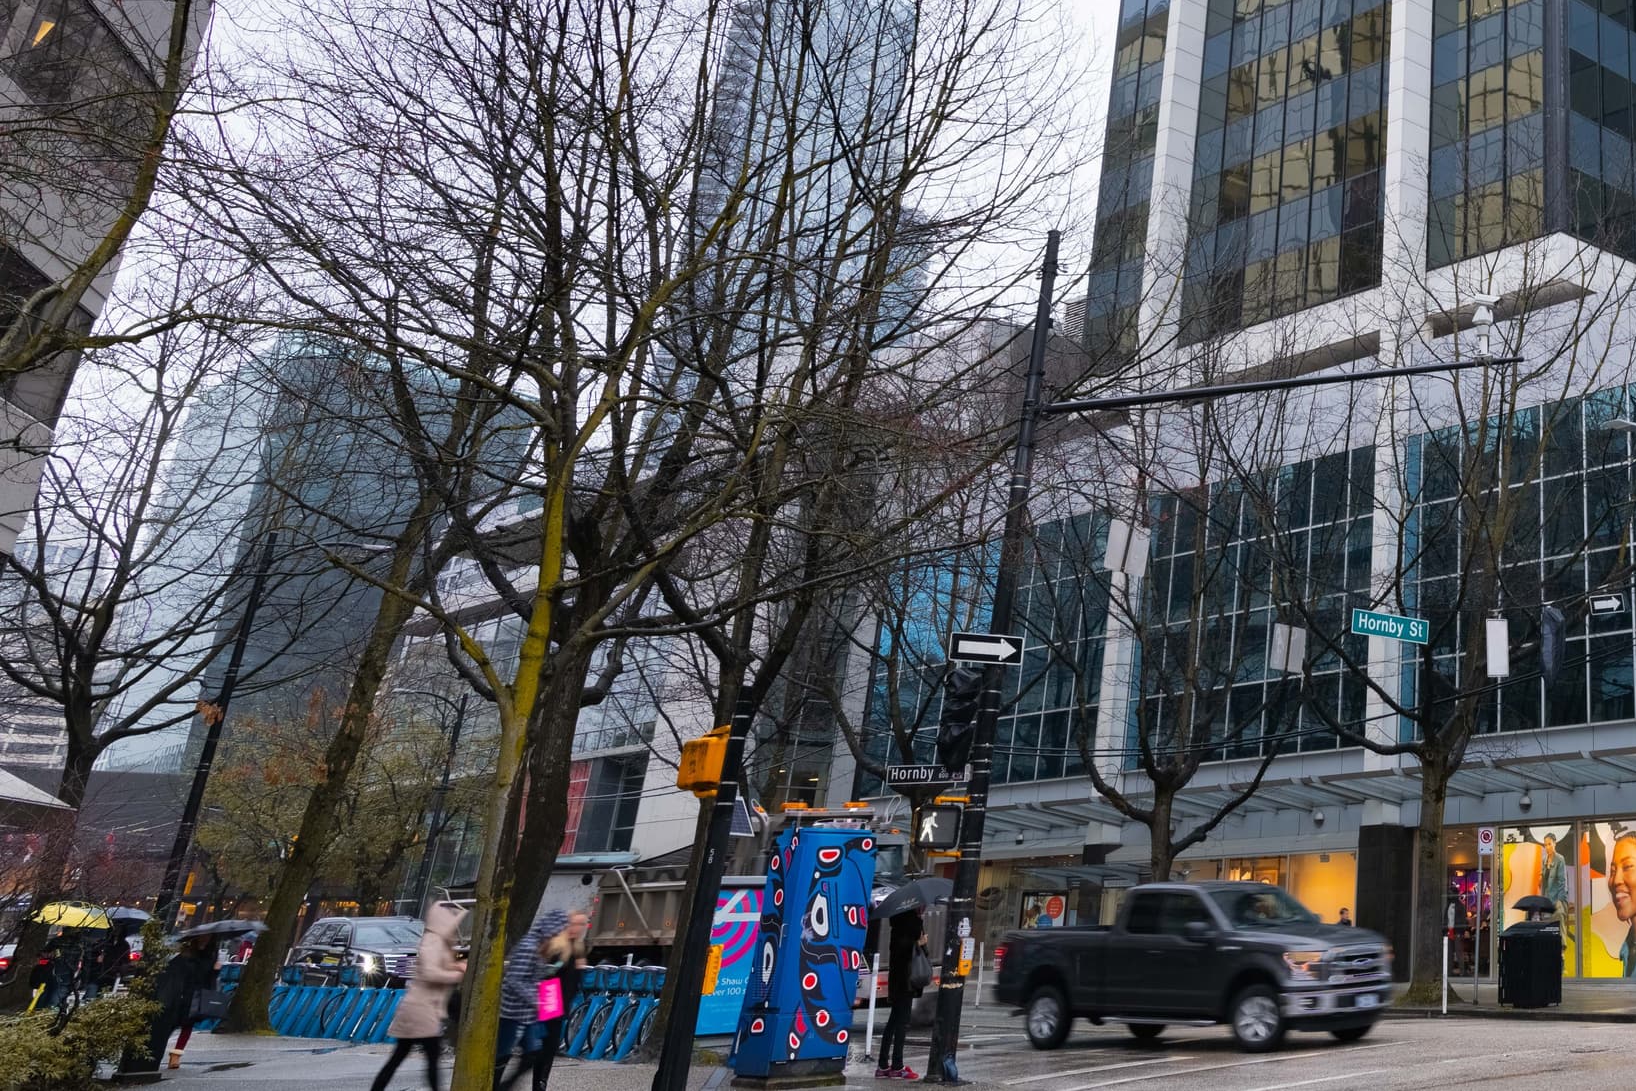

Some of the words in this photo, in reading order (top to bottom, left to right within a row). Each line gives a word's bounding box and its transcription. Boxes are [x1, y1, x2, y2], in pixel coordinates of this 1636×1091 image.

[1358, 613, 1404, 637] Hornby
[1409, 621, 1423, 638] St
[891, 766, 934, 783] Hornby
[721, 977, 743, 986] Shaw
[727, 986, 742, 996] 100
